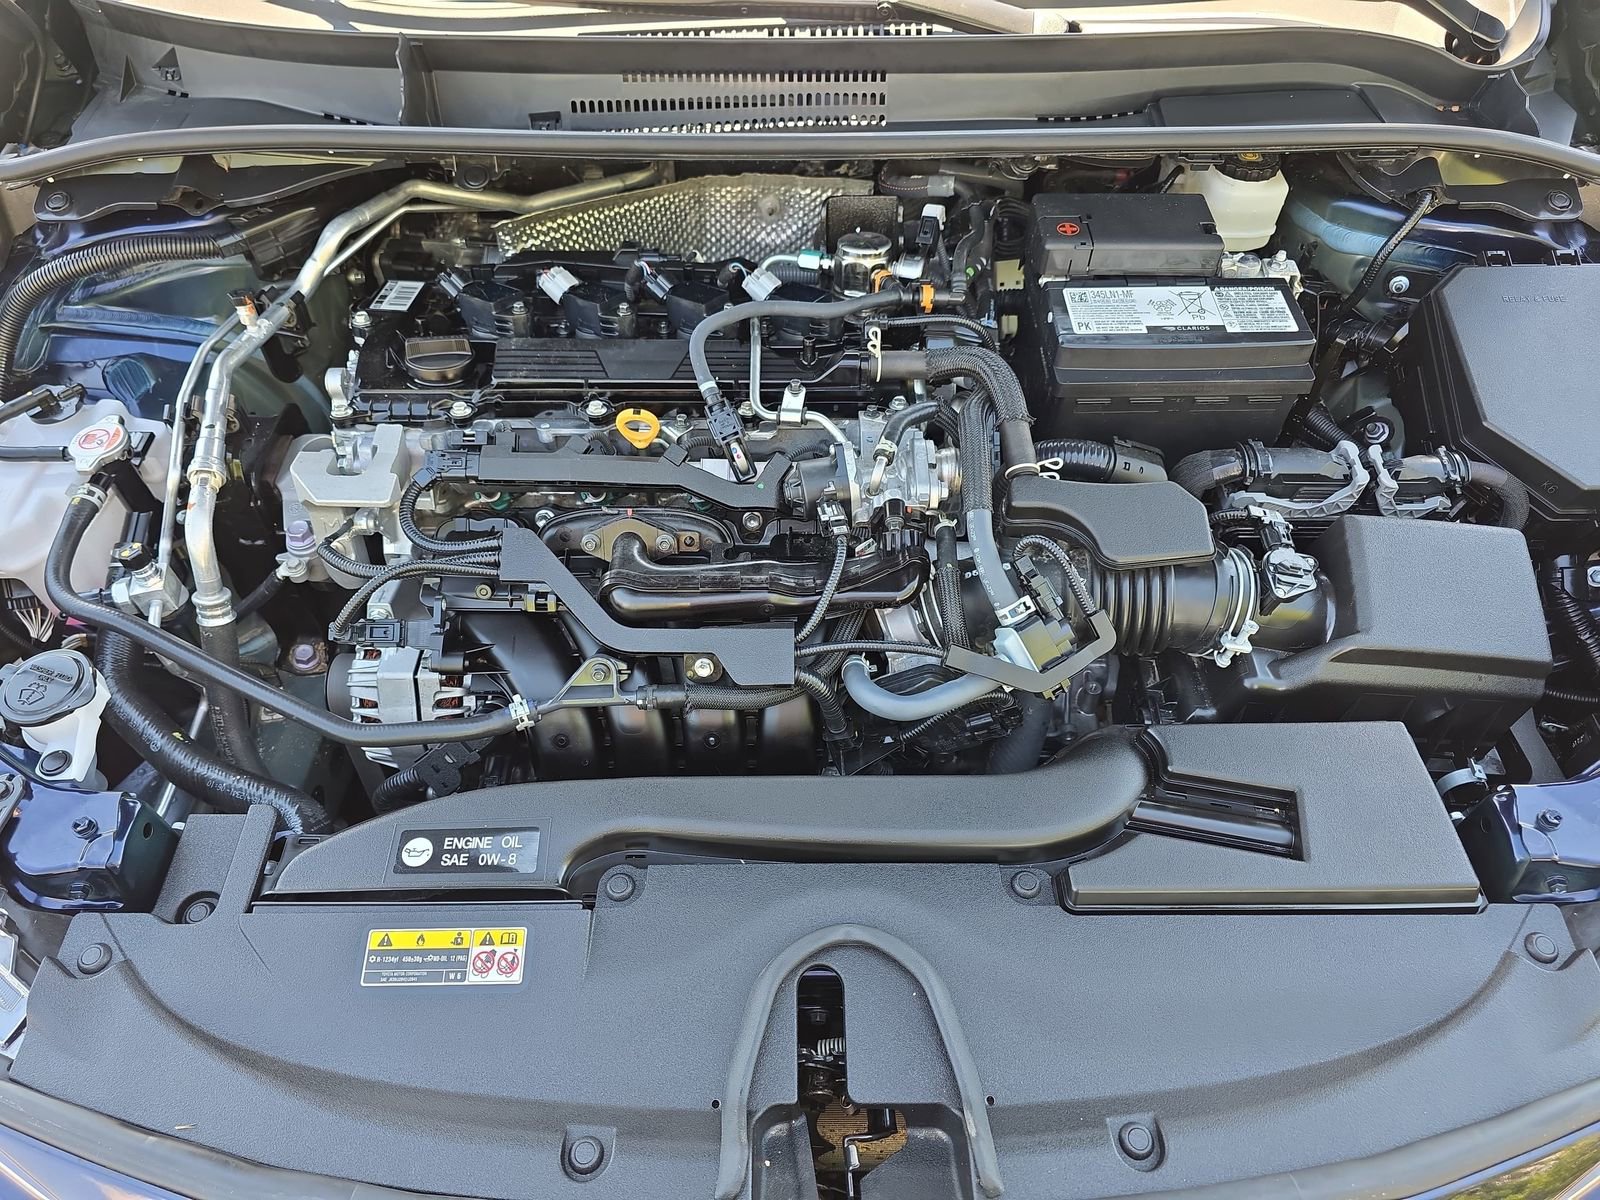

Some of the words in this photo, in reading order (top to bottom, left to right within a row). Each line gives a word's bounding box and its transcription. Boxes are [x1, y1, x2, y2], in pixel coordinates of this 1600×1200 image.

[1090, 290, 1134, 299] 345LN1-MF
[1077, 321, 1092, 331] PK
[443, 836, 493, 849] ENGINE
[501, 836, 523, 848] OIL
[440, 854, 469, 866] SAE
[478, 853, 517, 866] 0W-8
